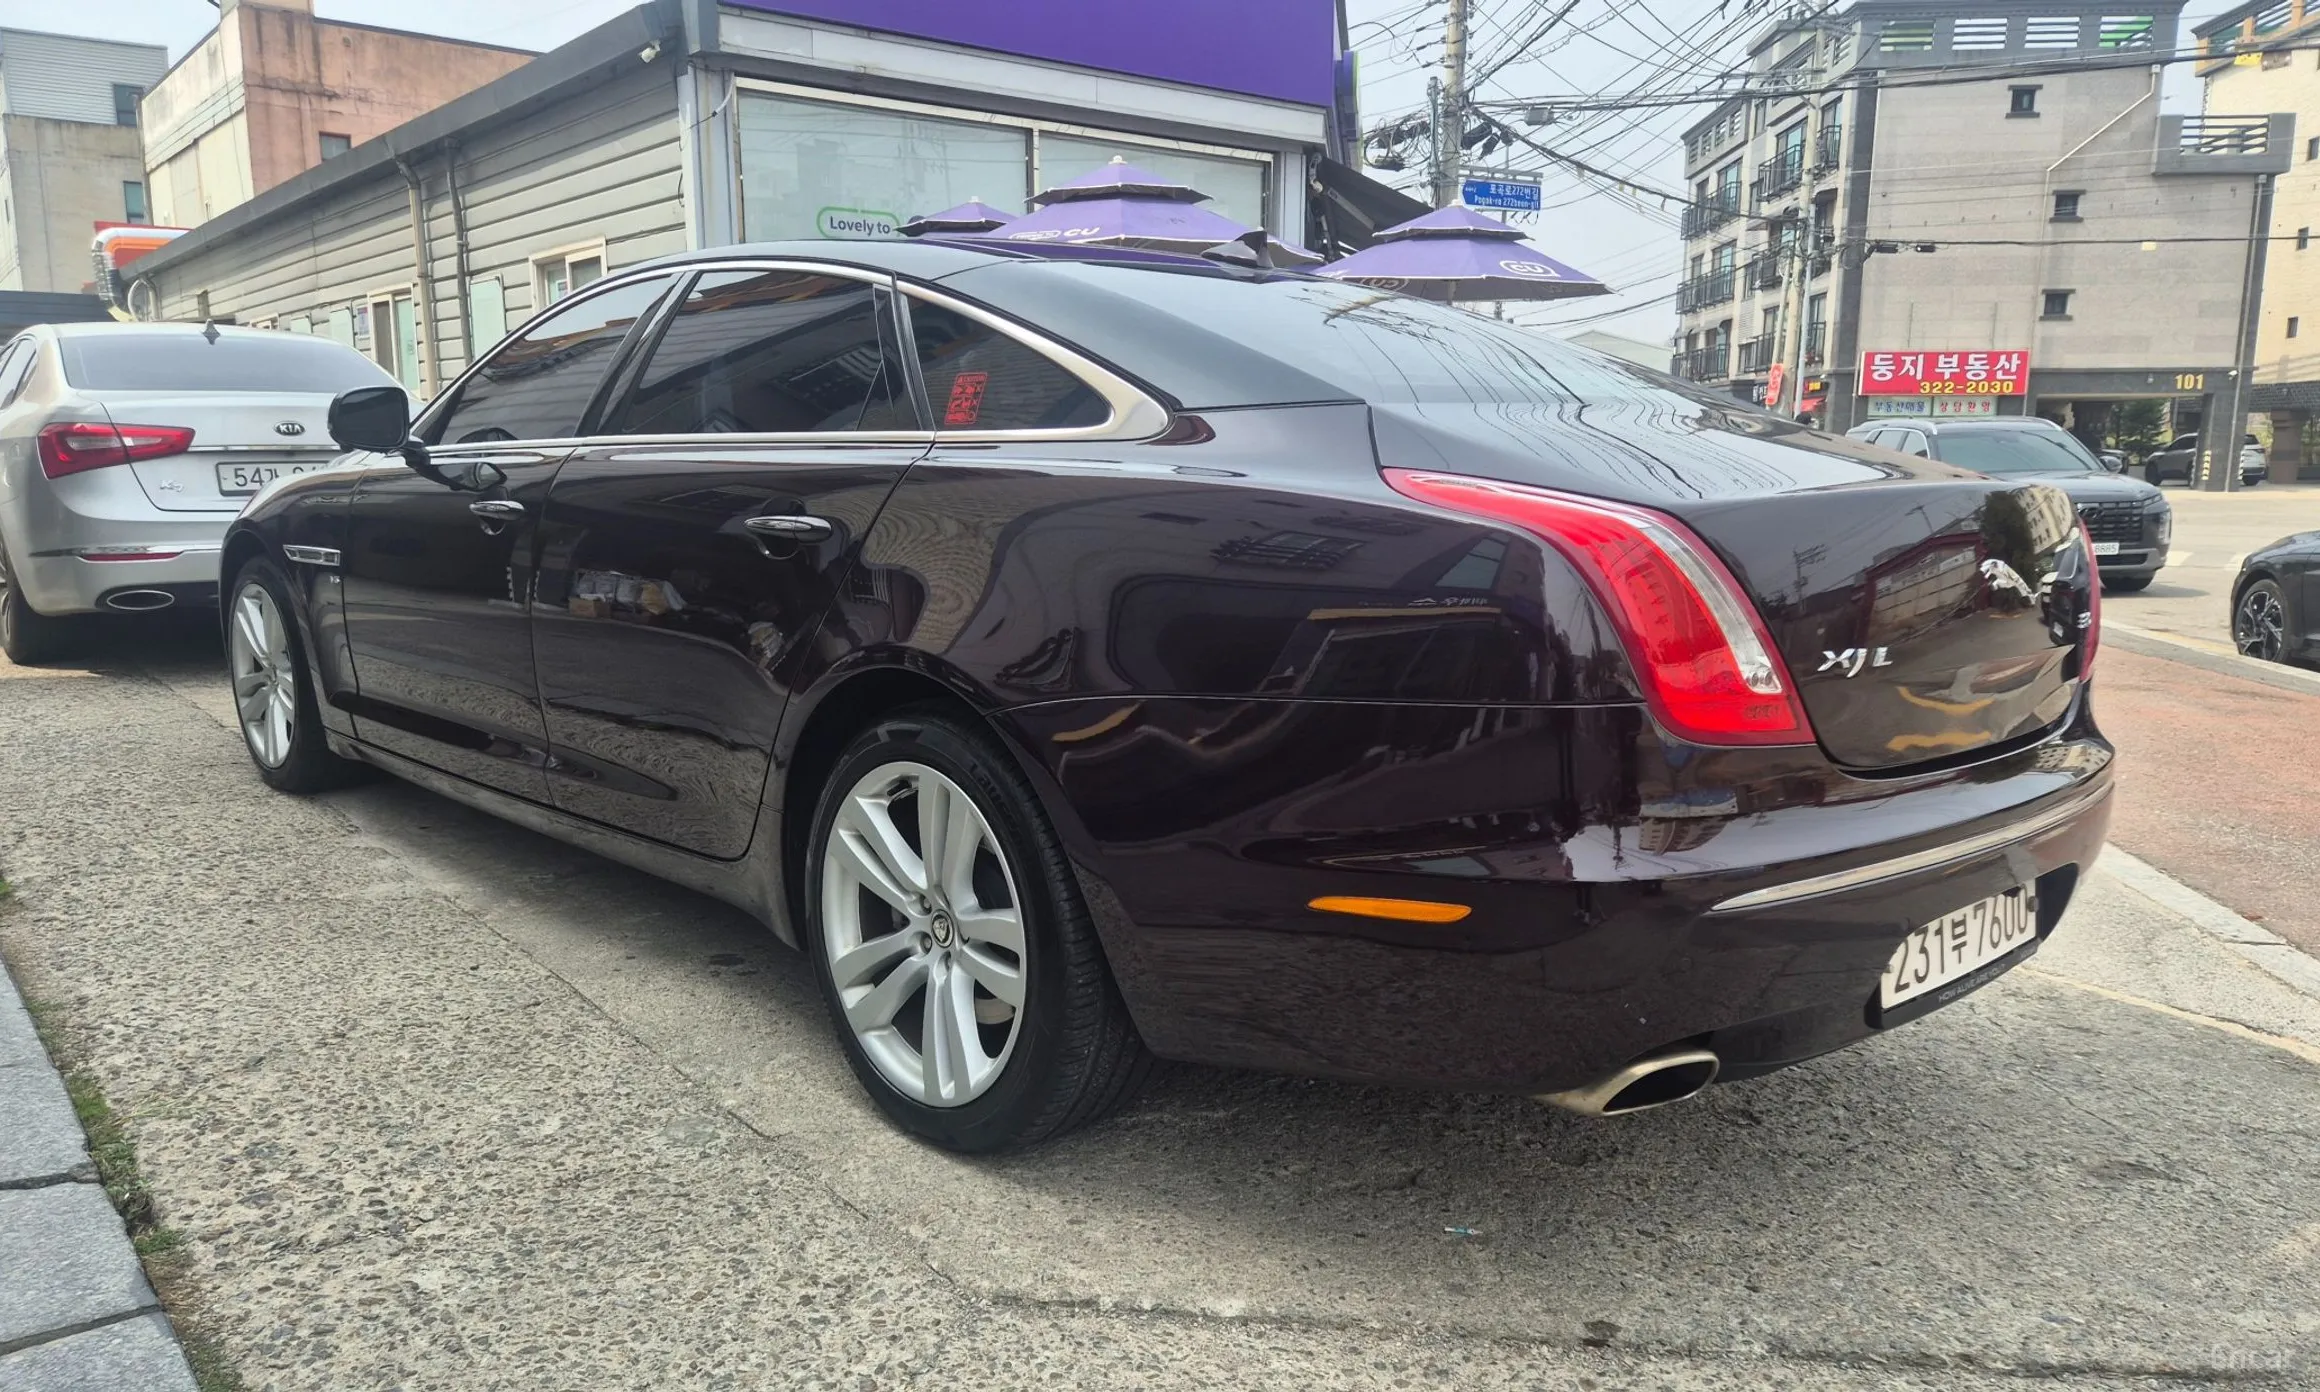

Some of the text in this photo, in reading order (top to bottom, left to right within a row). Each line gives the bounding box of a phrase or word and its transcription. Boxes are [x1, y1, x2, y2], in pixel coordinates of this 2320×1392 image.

[829, 215, 891, 234] Lovely to
[1063, 226, 1101, 237] CU
[1509, 263, 1545, 273] CU
[1870, 352, 2021, 381] 둥지 부동산
[1919, 381, 2014, 394] 322-2030
[2174, 373, 2204, 390] 101
[278, 423, 302, 434] KIA
